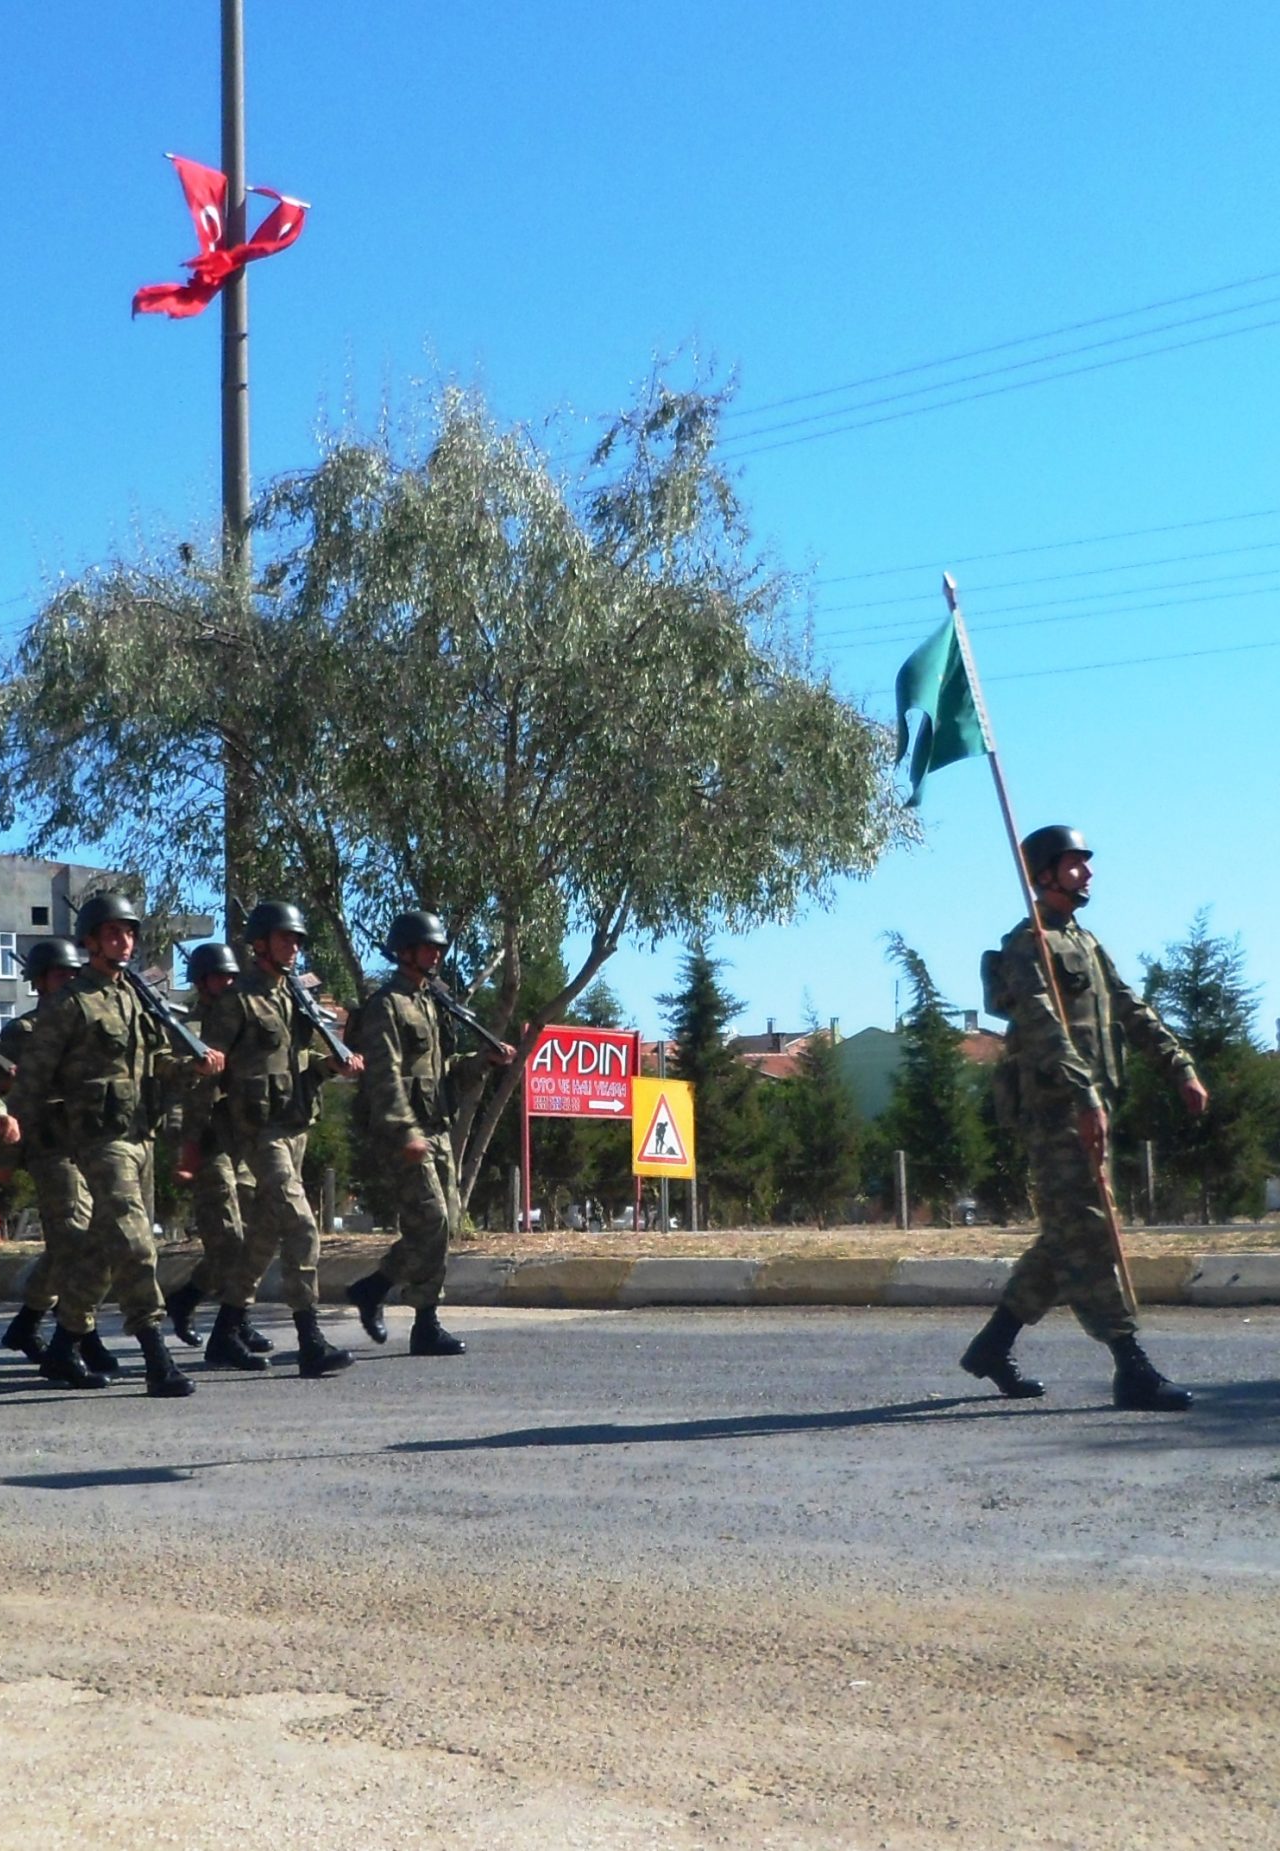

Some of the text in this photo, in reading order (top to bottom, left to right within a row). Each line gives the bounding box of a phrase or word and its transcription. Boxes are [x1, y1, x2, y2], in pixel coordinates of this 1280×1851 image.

[531, 1039, 628, 1077] AYDIN
[530, 1077, 556, 1094] OTO
[558, 1078, 570, 1095] VE
